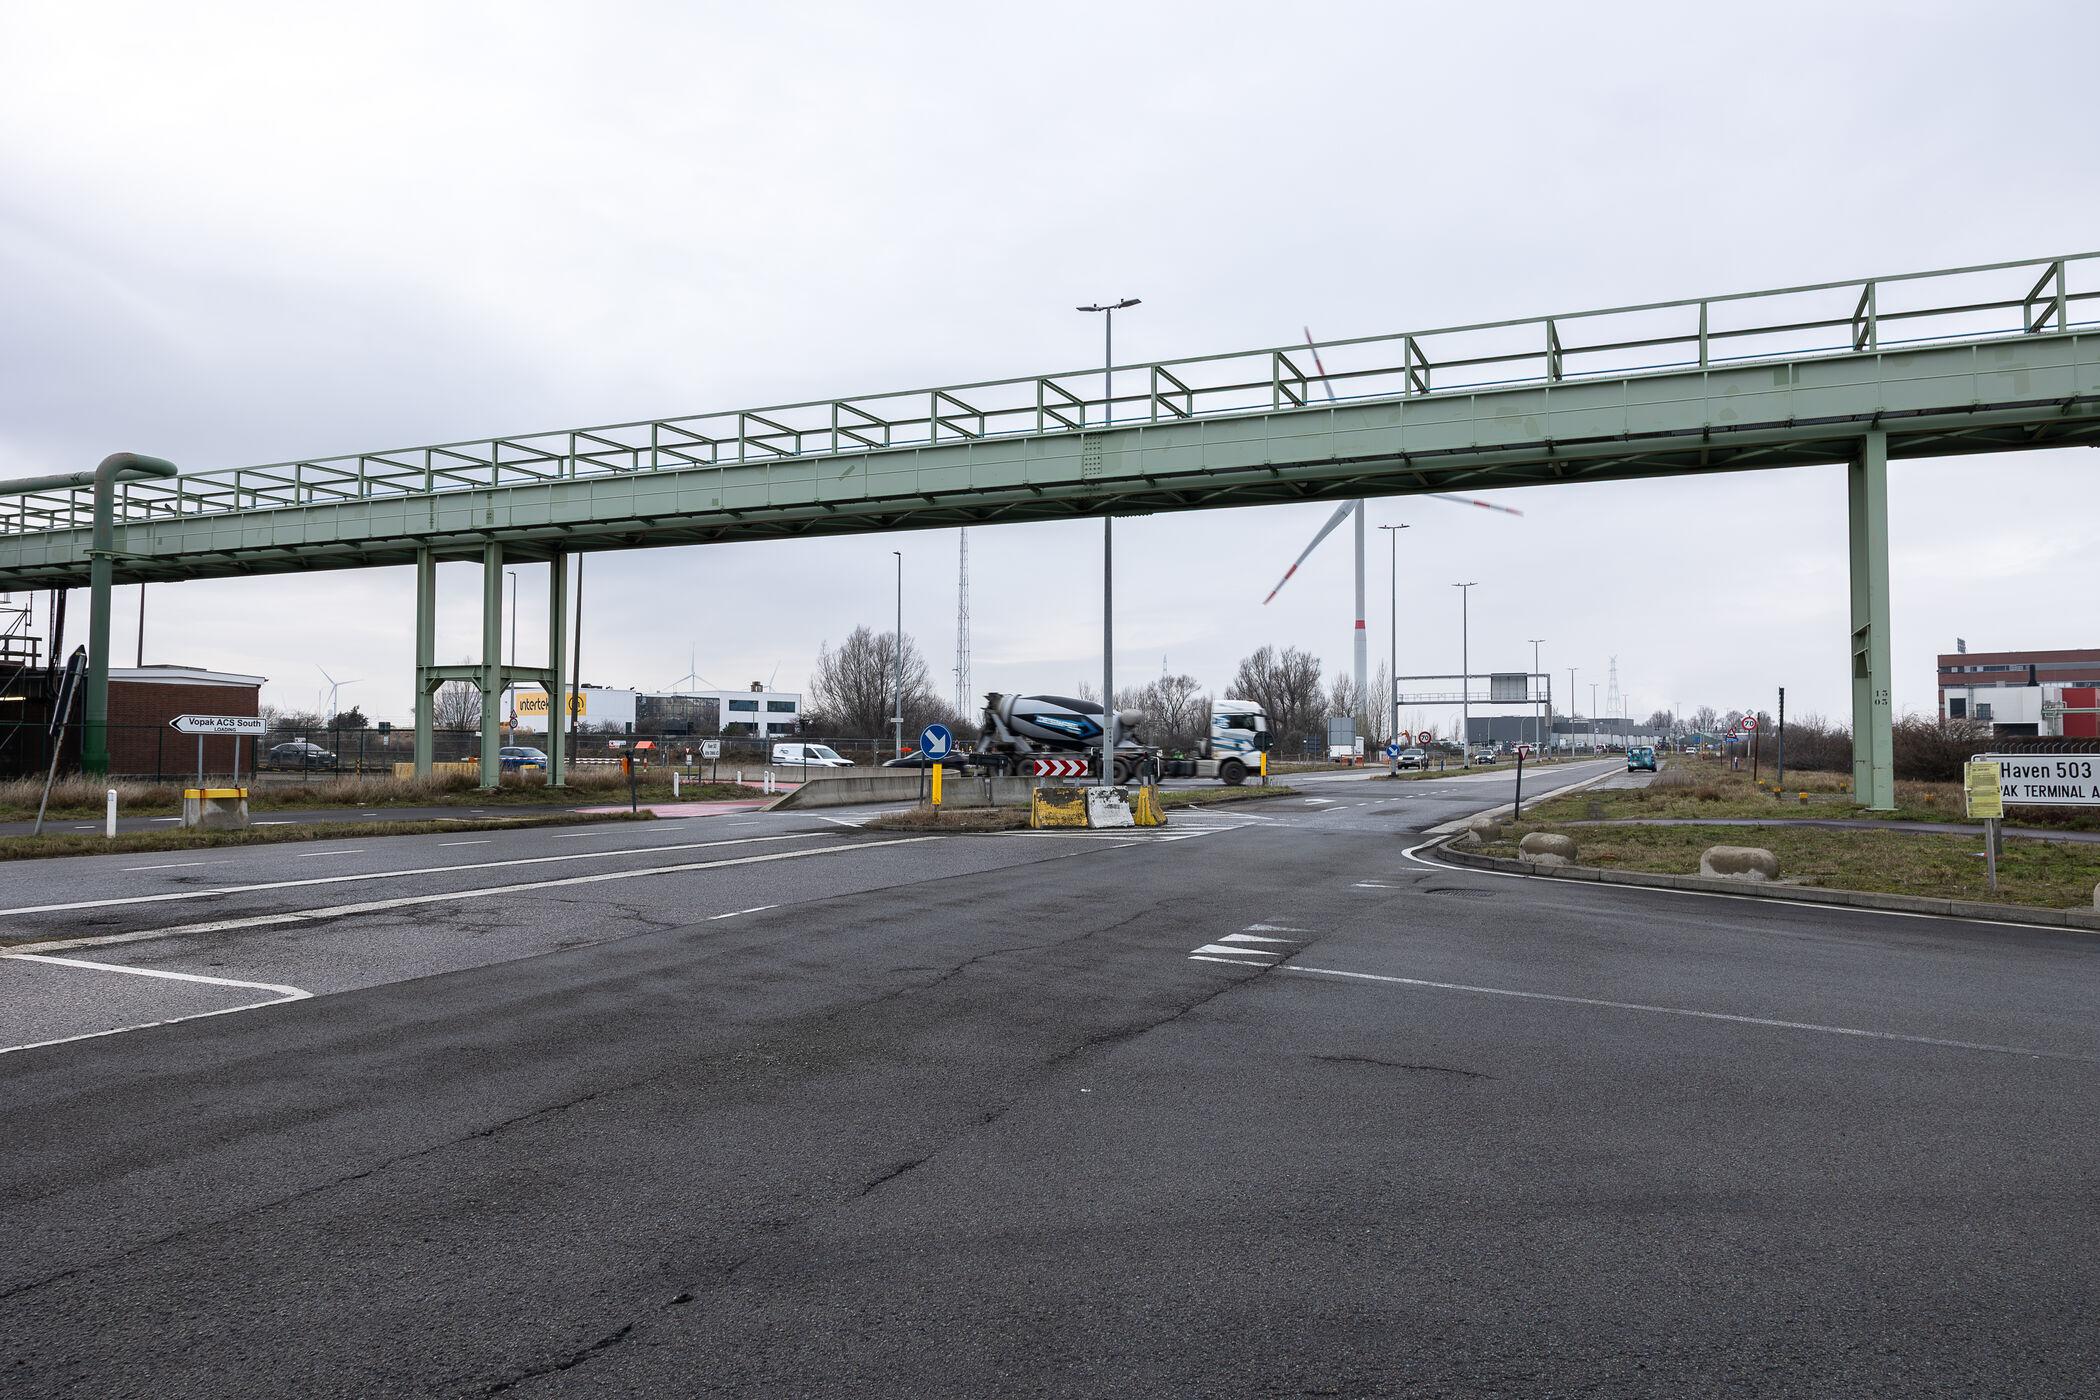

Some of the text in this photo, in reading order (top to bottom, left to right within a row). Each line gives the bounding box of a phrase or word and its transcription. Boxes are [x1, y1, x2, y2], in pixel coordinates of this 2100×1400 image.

[189, 718, 261, 727] Vopak ACS South
[2001, 761, 2092, 778] Haven 503
[2024, 785, 2086, 798] TERMINAL
